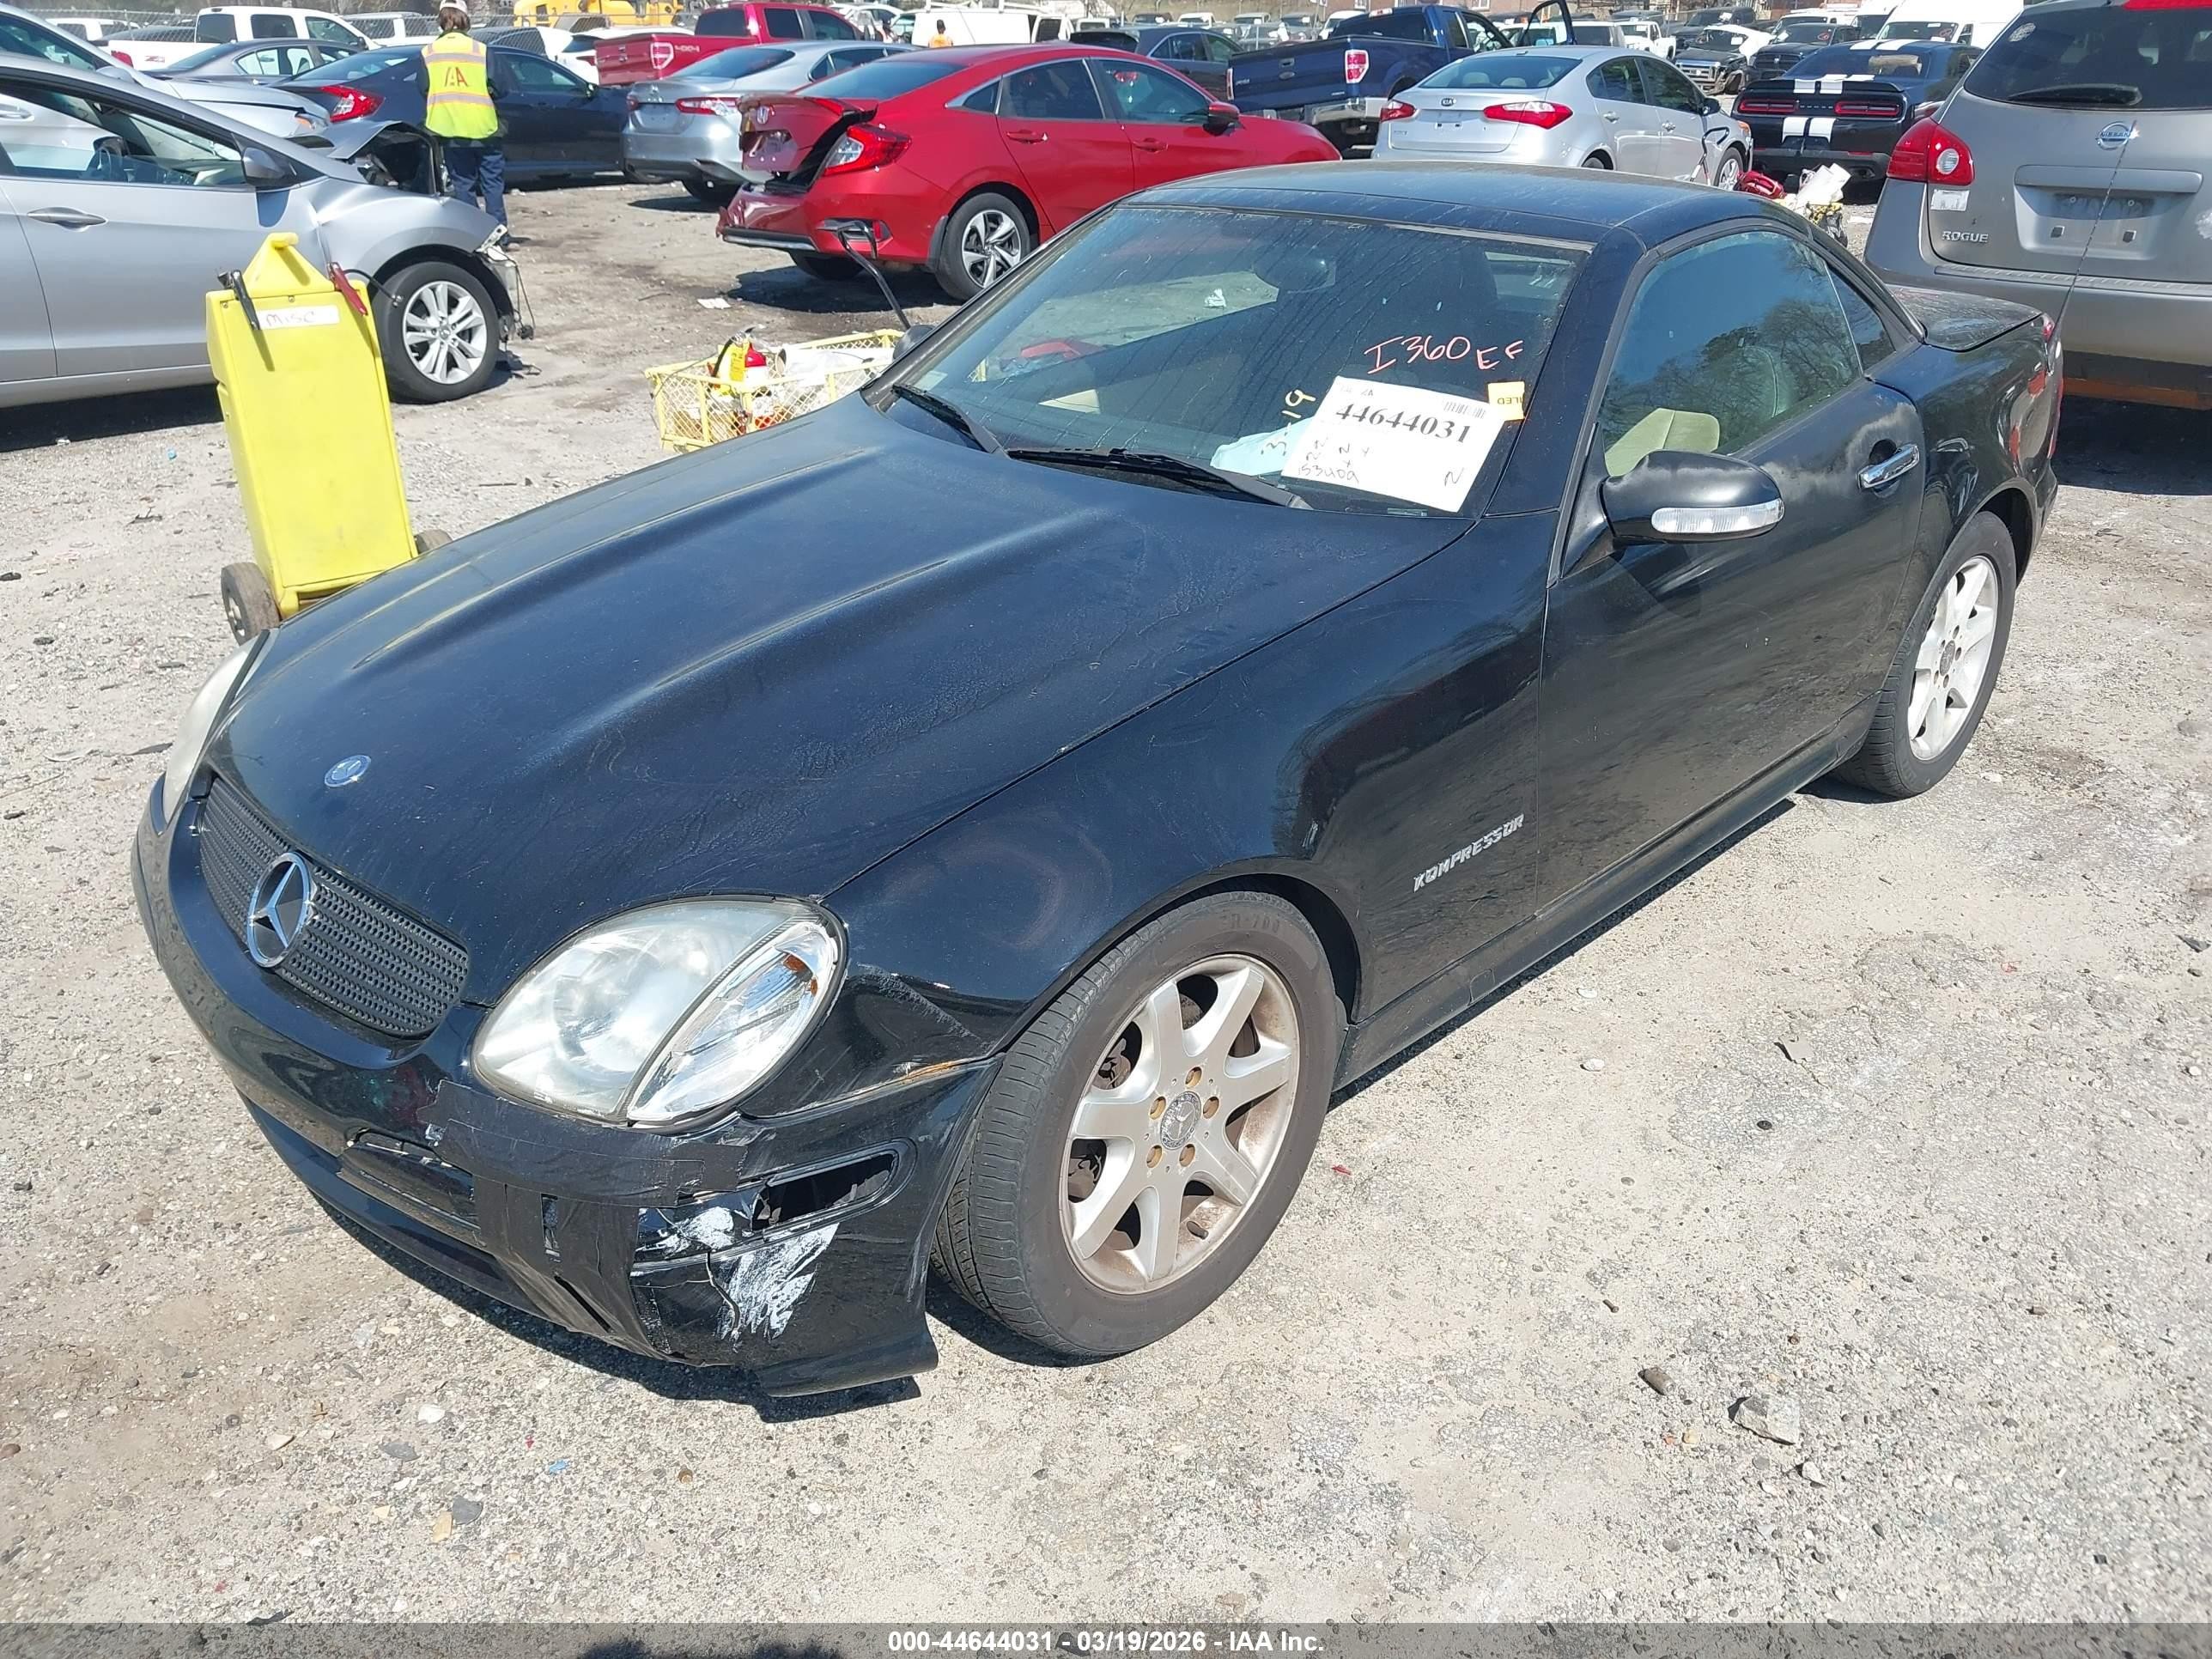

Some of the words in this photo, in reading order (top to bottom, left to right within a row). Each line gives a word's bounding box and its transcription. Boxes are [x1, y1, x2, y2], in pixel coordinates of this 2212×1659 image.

[1942, 230, 1989, 243] ROGUE
[1335, 403, 1471, 444] 44644031
[1413, 813, 1525, 893] KOMPRESSOR
